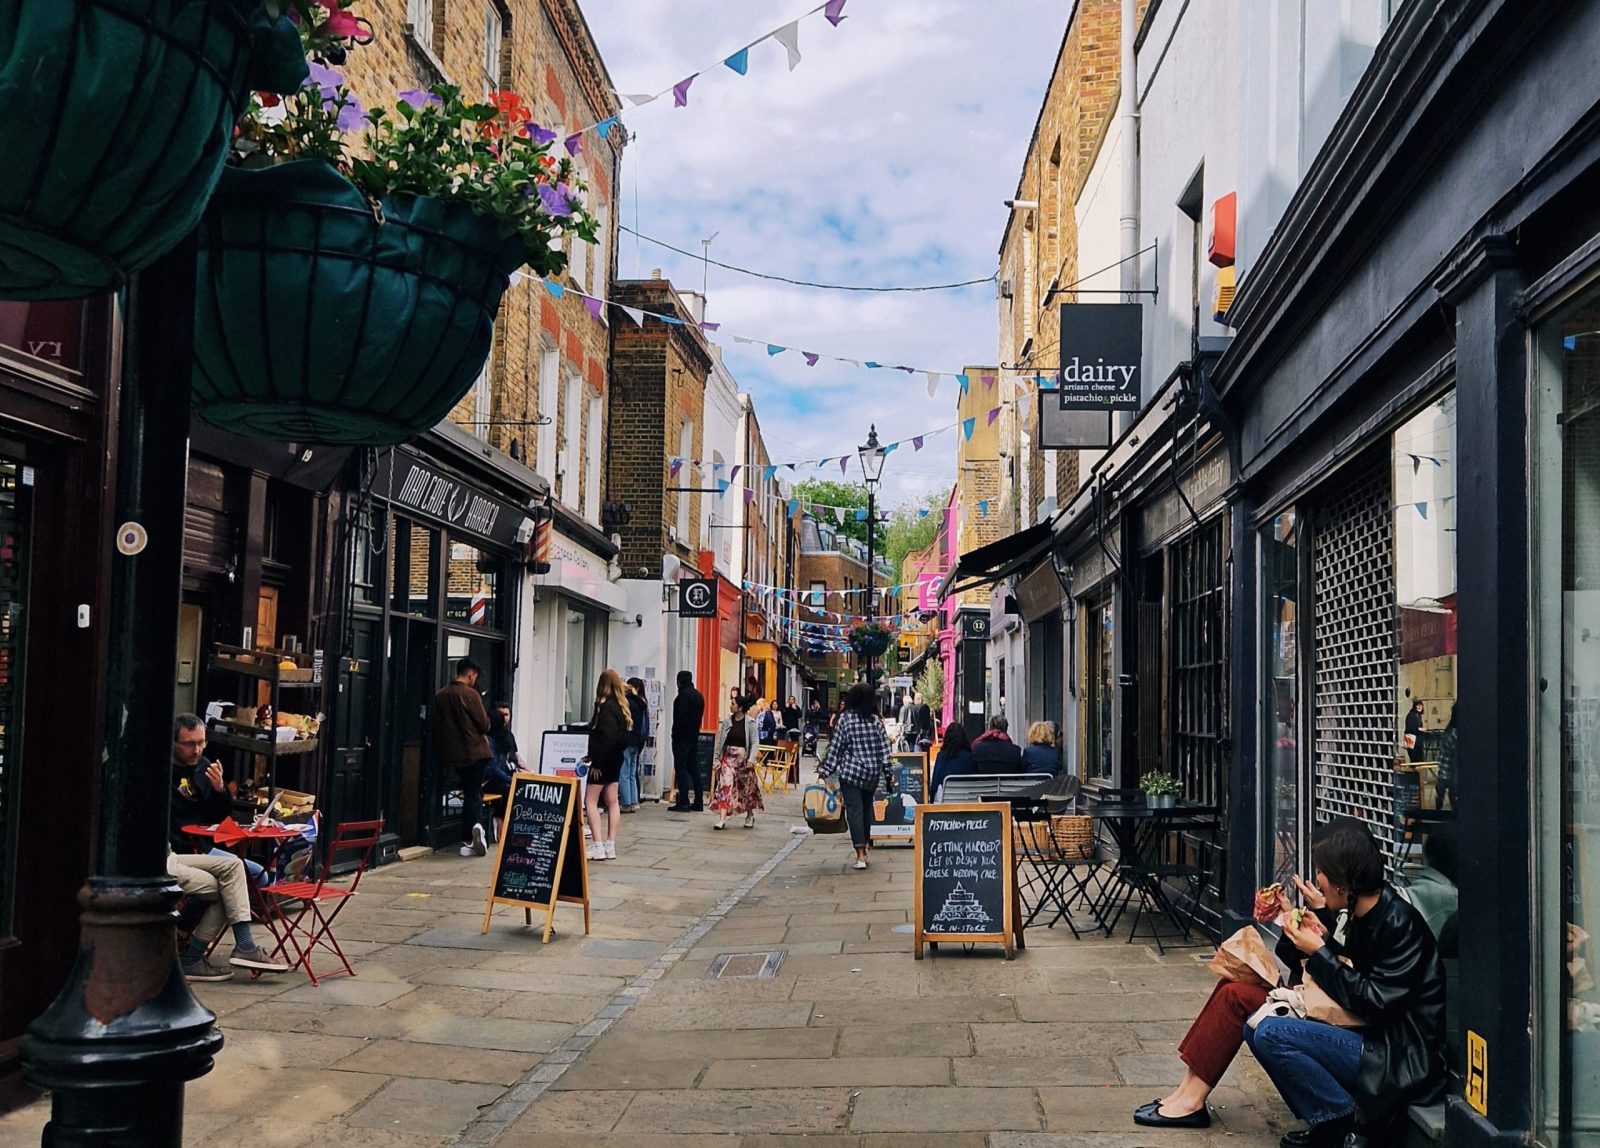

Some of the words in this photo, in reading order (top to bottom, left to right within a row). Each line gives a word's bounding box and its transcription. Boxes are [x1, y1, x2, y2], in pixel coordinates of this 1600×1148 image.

[1064, 356, 1137, 390] dairy
[1064, 383, 1089, 391] artisan
[1091, 383, 1116, 391] cheese
[302, 449, 313, 462] 19
[398, 464, 431, 507] MAN
[421, 475, 453, 516] CAVE
[464, 495, 500, 536] BARBER
[524, 783, 563, 805] ITALIAN
[930, 841, 965, 857] GETTING
[965, 839, 1001, 853] MARRIED?
[928, 857, 941, 868] LET
[945, 856, 953, 866] US
[955, 856, 977, 867] DESIGN
[925, 868, 949, 878] CHEESE
[953, 868, 979, 882] WEDDING
[930, 923, 945, 931] ASK
